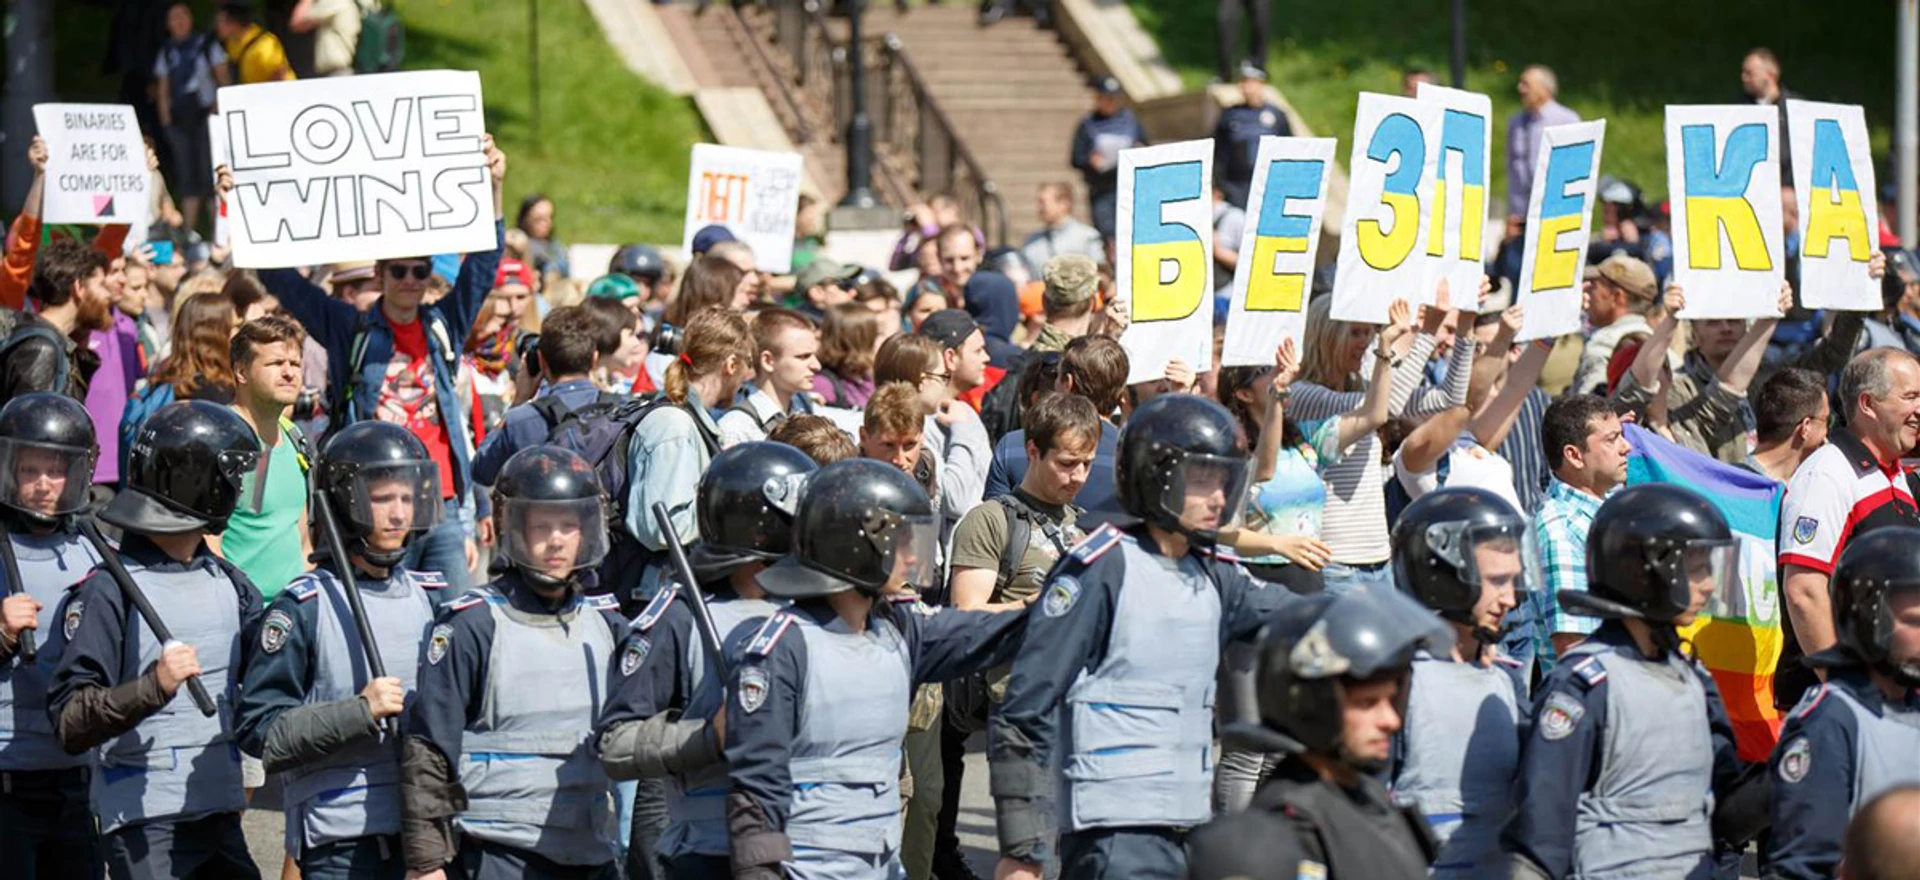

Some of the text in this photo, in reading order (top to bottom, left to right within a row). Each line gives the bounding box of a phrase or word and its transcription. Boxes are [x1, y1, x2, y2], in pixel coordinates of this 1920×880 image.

[63, 112, 126, 131] BINARIES
[227, 94, 482, 172] LOVE
[70, 143, 128, 161] ARE FOR
[58, 173, 145, 192] COMPUTERS
[235, 166, 485, 244] WINS
